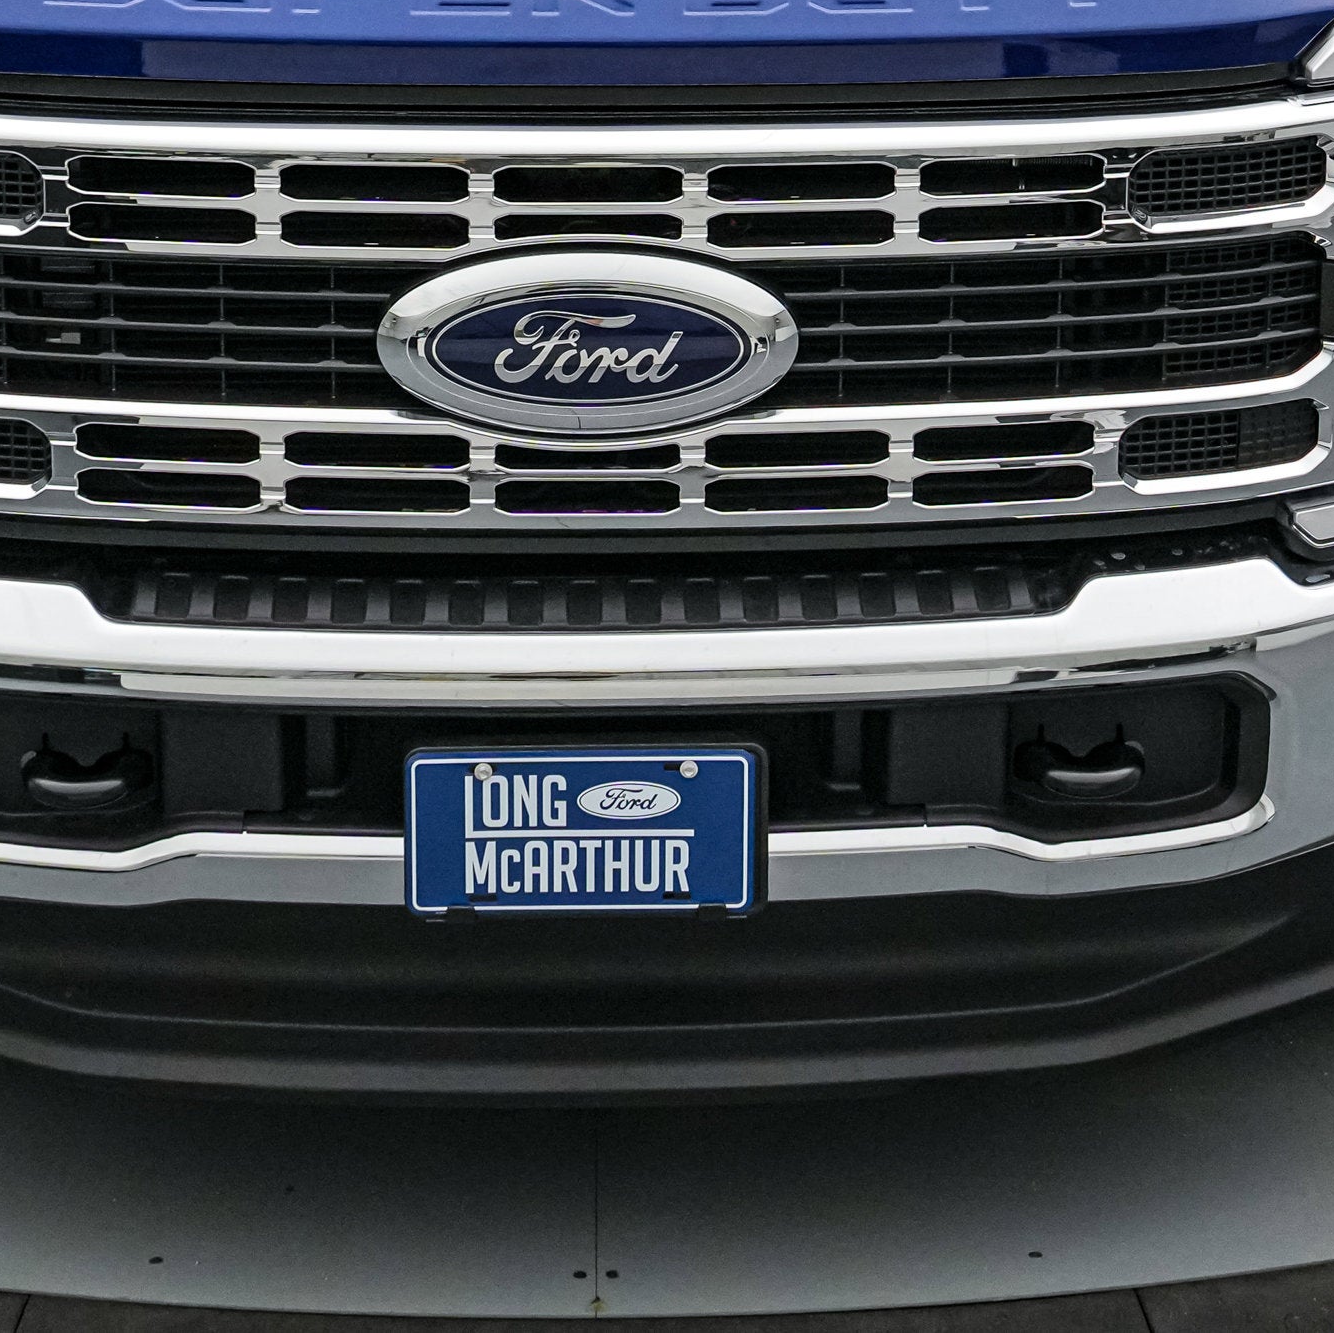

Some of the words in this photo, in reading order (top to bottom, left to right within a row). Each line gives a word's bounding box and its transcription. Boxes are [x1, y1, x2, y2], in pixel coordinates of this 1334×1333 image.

[494, 309, 684, 384] Ford
[465, 773, 567, 839] LONG
[599, 788, 659, 811] Ford
[465, 839, 690, 895] McARTHUR
